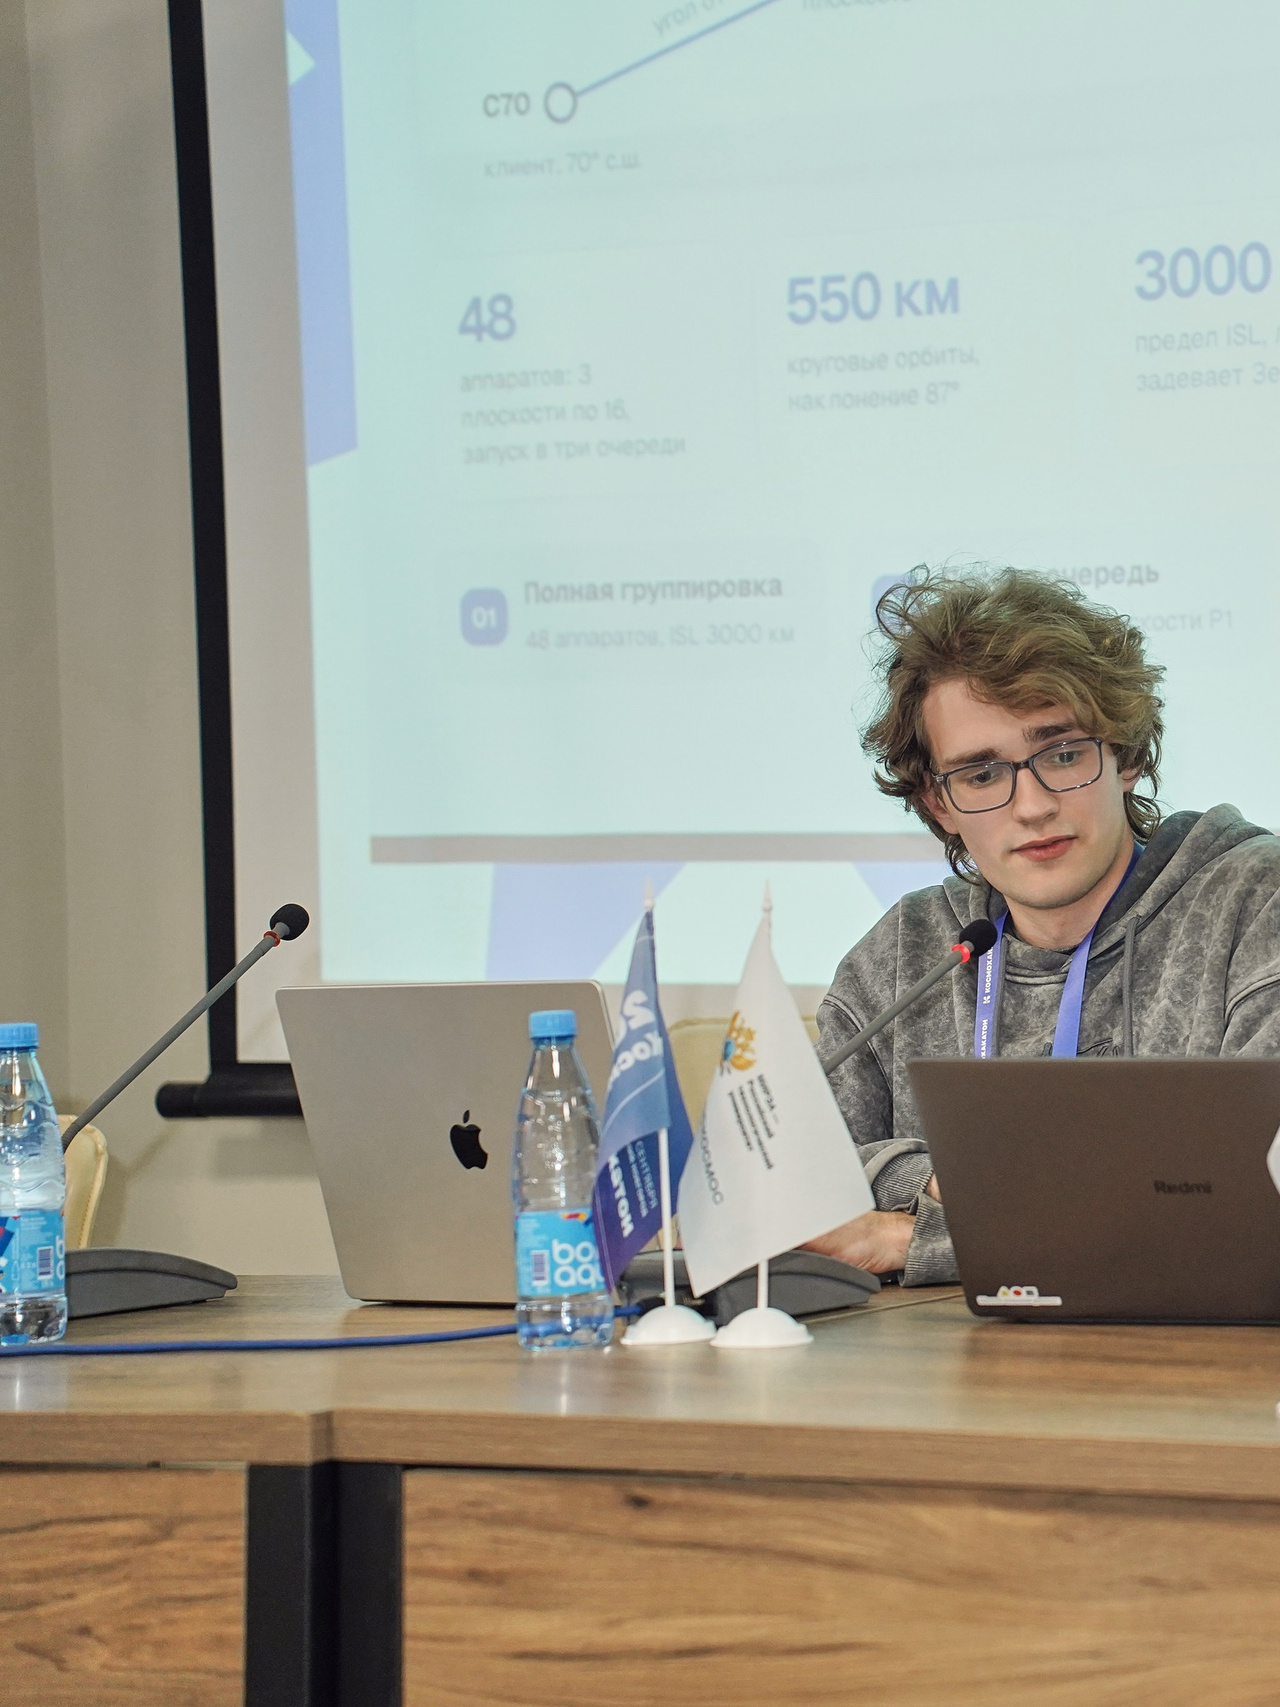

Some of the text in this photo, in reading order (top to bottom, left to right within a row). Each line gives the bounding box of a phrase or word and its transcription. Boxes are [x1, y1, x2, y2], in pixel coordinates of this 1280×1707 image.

[482, 91, 532, 119] C70
[565, 151, 600, 174] 70°
[604, 151, 642, 171] с.ш.
[1134, 241, 1272, 301] 3000
[786, 271, 961, 326] 550 км
[457, 292, 518, 343] 48
[1135, 330, 1218, 353] предел
[1226, 322, 1267, 348] ISL,
[787, 345, 980, 377] круговые орбиты,
[459, 363, 592, 392] аппаратов: 3
[1136, 366, 1243, 393] задевает
[787, 381, 960, 412] наклонение 87°
[460, 398, 632, 428] плоскости по 16,
[463, 436, 687, 466] запуск в три очереди
[523, 577, 784, 605] Полная группировка
[471, 606, 497, 629] 01
[554, 628, 664, 648] аппаратов,
[669, 625, 700, 646] ISL
[706, 623, 763, 645] 3000
[1153, 1180, 1212, 1194] Redmi
